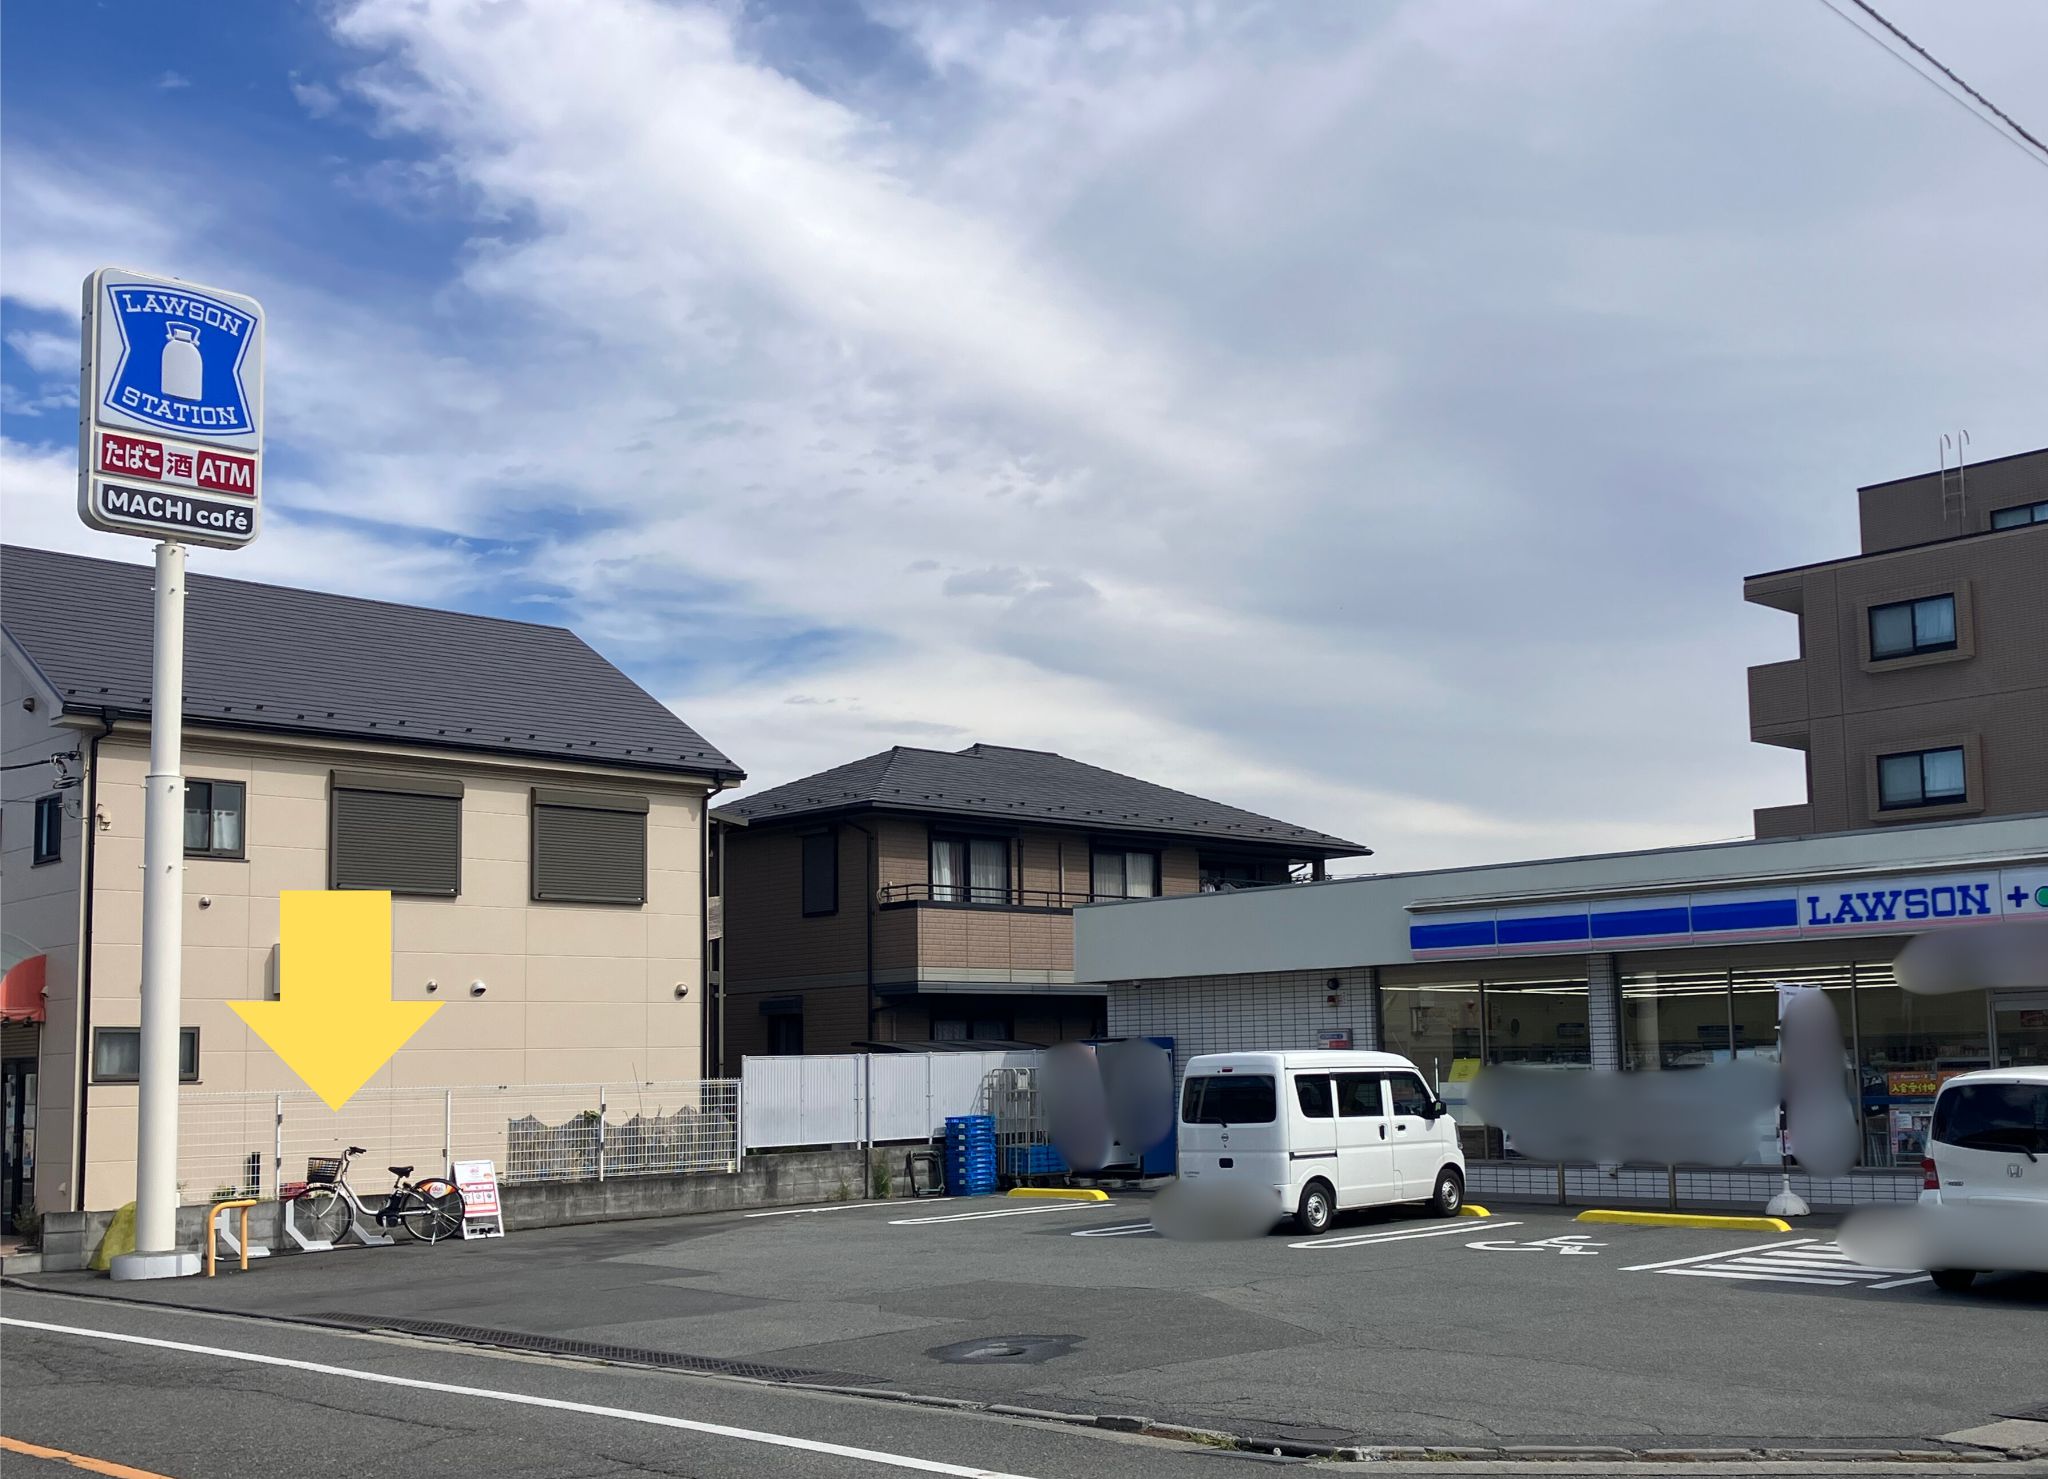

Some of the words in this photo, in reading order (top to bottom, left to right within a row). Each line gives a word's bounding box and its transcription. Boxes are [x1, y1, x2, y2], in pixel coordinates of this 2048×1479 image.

[123, 293, 242, 337] LAWSON
[121, 386, 238, 425] STATION
[105, 440, 161, 473] たばこ
[166, 451, 194, 479] 酒
[199, 458, 251, 488] ATM
[107, 490, 192, 522] MACHI
[196, 509, 248, 530] café
[1807, 883, 1991, 926] LAWSON
